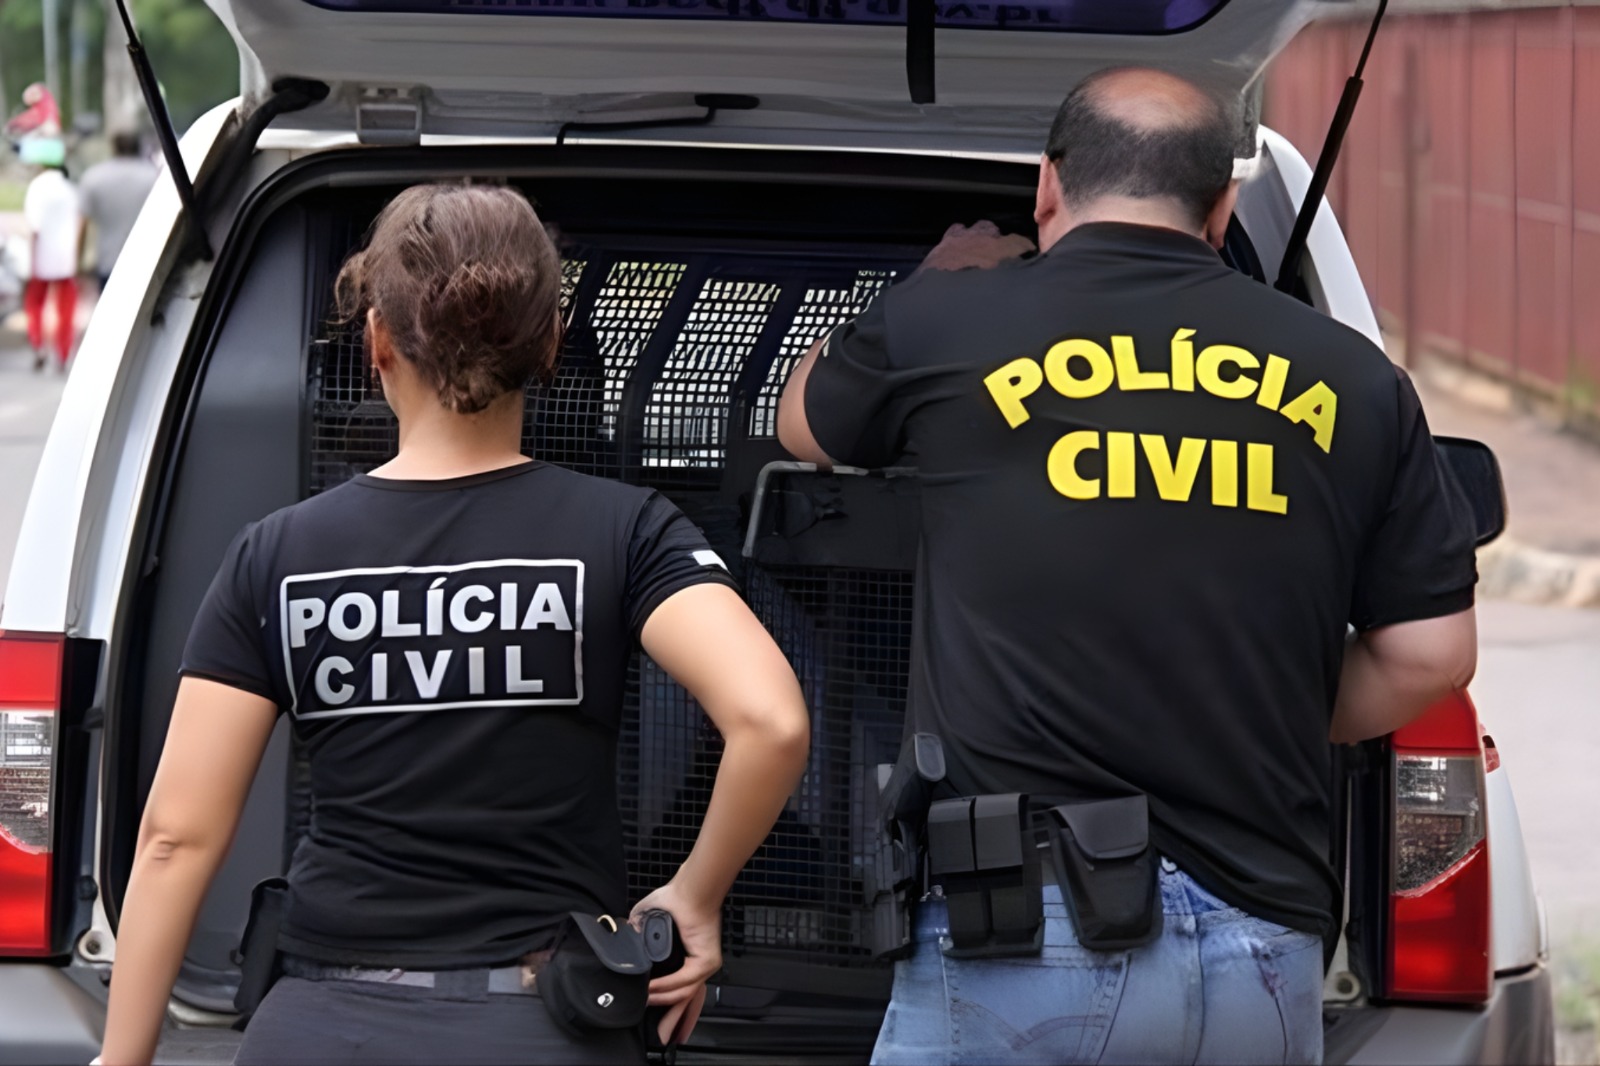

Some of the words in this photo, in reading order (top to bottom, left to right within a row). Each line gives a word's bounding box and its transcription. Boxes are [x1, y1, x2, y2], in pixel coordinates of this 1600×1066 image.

[983, 327, 1338, 453] POLÍCIA
[1046, 430, 1288, 515] CIVIL
[288, 576, 573, 649] POLÍCIA
[314, 645, 544, 706] CIVIL
